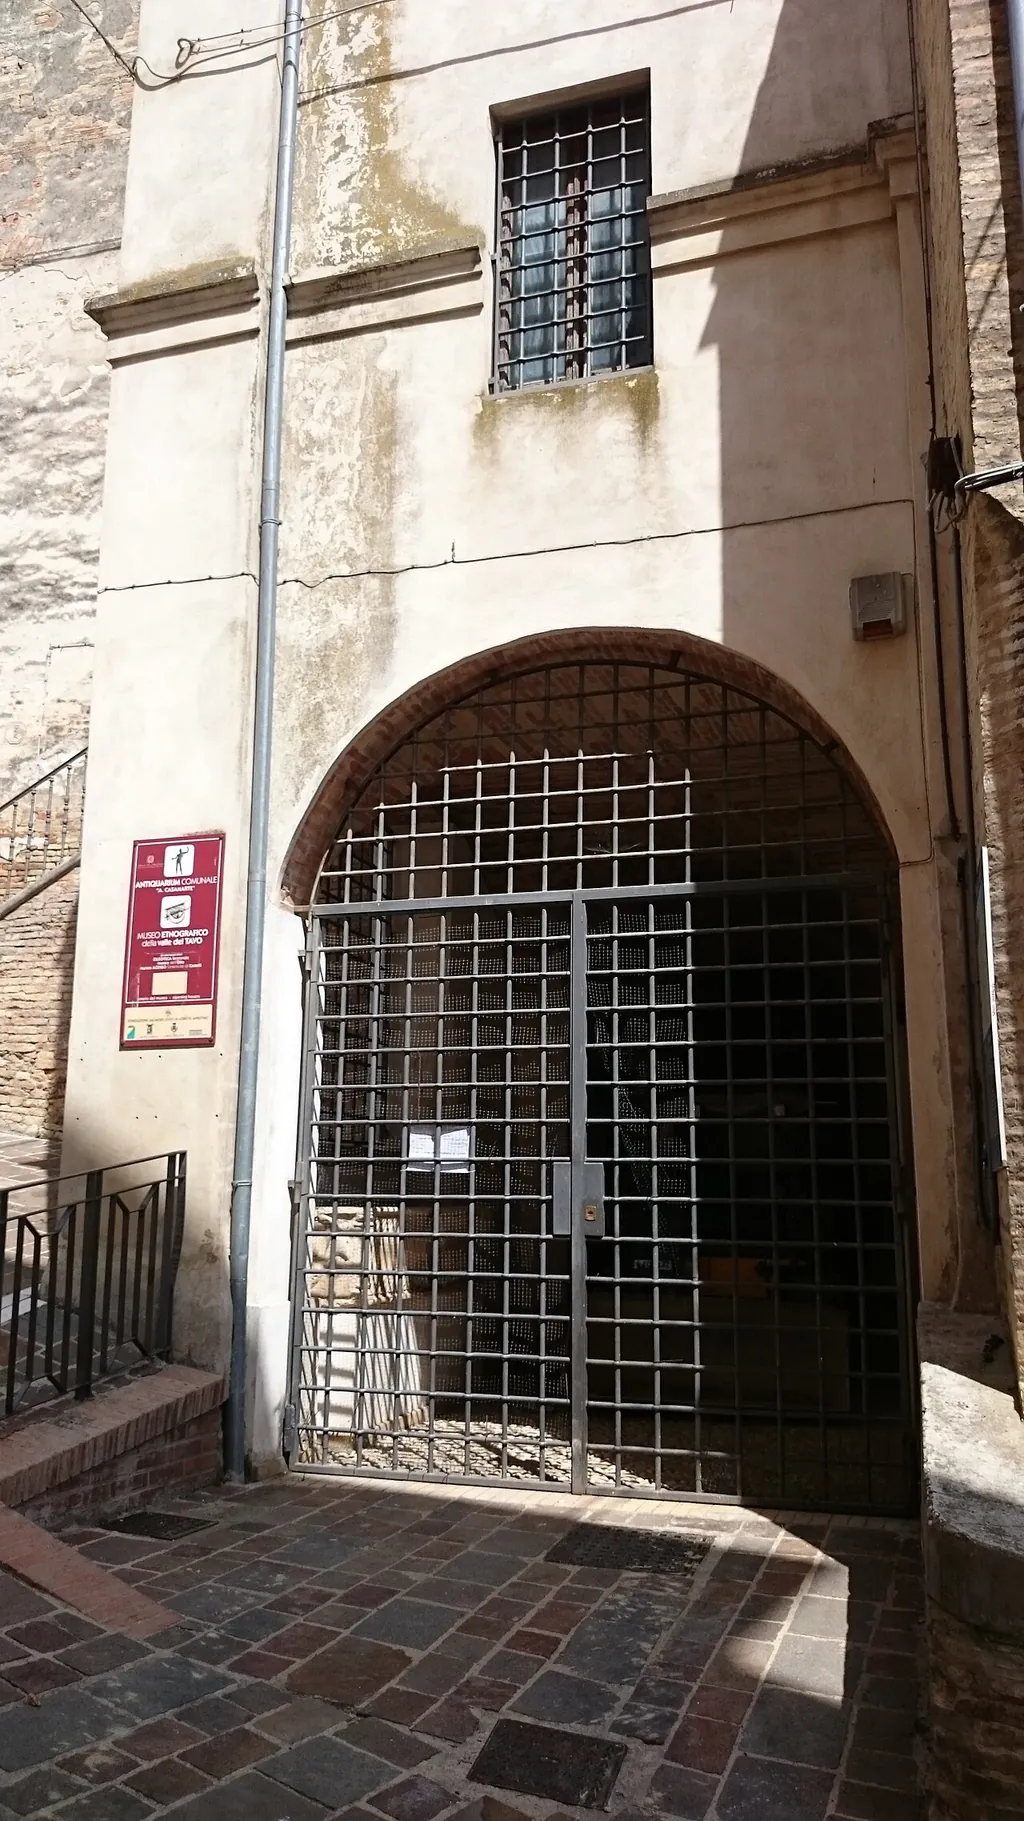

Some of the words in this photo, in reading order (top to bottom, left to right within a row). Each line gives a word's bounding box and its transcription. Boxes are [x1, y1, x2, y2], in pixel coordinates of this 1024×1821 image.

[135, 879, 180, 888] ANTIQUARIUM
[181, 876, 218, 885] COMUNALE
[137, 931, 160, 940] MUSEO
[161, 929, 209, 938] ETNOGRAFICO
[173, 938, 184, 946] del
[185, 937, 203, 945] TAVO
